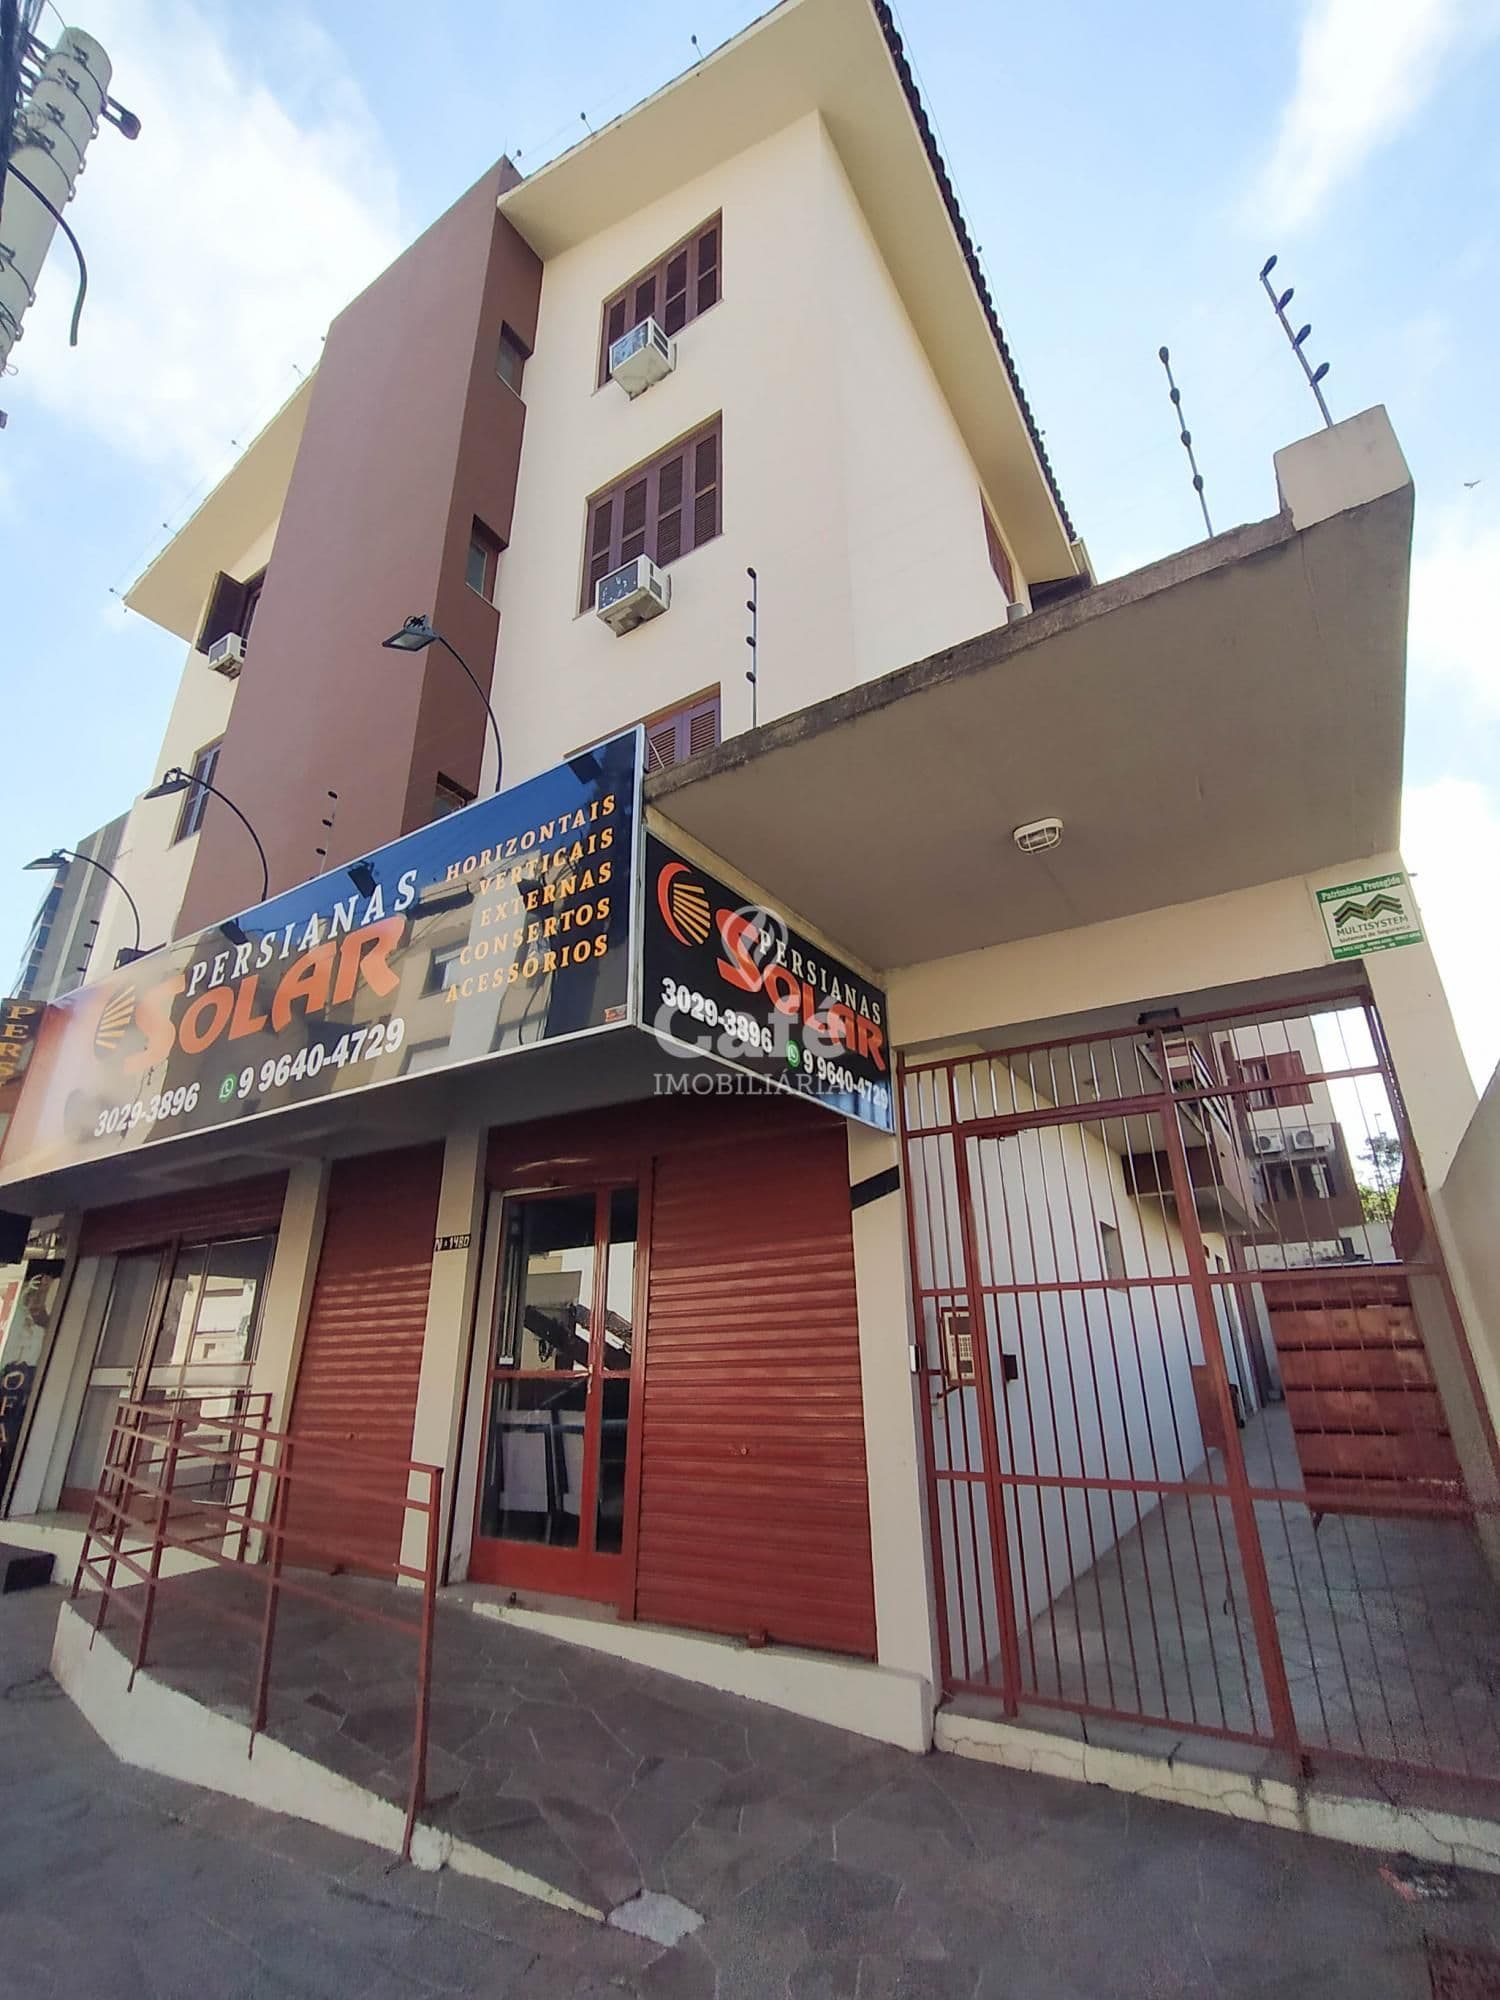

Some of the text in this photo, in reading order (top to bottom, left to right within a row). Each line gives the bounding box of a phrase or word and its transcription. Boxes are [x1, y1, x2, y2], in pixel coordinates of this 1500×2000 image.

[445, 794, 616, 882] HORIZONTAIS
[479, 827, 614, 895] VERTICAIS
[480, 861, 612, 928] EXTERNAS
[1336, 916, 1408, 936] MULTISYSTEM
[186, 869, 418, 997] PERSIANAS
[460, 897, 611, 965] CONSERTOS
[121, 913, 405, 1074] SOLAR
[445, 934, 609, 1004] ACESSÓRIOS
[716, 909, 886, 1071] SOLAR
[757, 928, 881, 1025] PERSIANAS
[661, 977, 773, 1052] 3029-3896
[237, 1018, 405, 1099] 9 9640-4729
[803, 1049, 888, 1110] 9 9640-4729
[94, 1082, 200, 1137] 3029-3896
